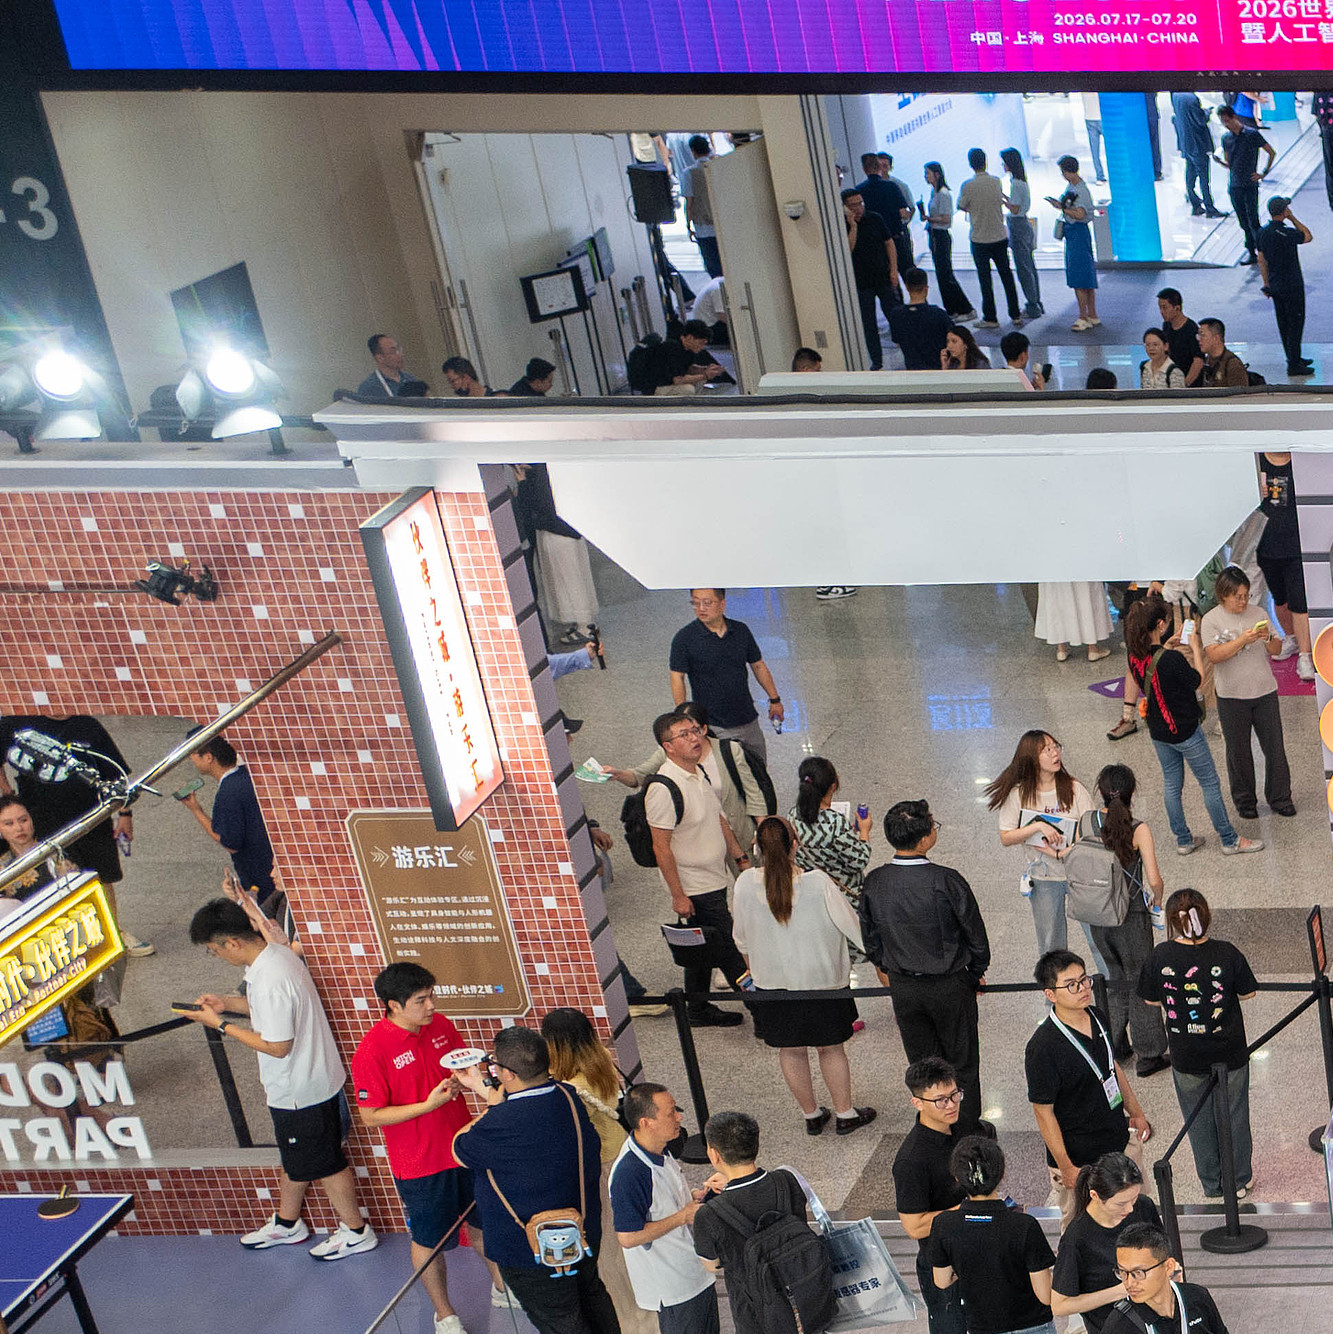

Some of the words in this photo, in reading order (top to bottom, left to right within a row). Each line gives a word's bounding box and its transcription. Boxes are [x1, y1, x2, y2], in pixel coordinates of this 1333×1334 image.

[1053, 13, 1197, 26] 2026.07.17-07.20
[391, 845, 458, 869] 游乐汇
[33, 972, 68, 1003] Partner
[68, 956, 87, 980] City
[432, 984, 494, 995] 登时代·伙伴之城
